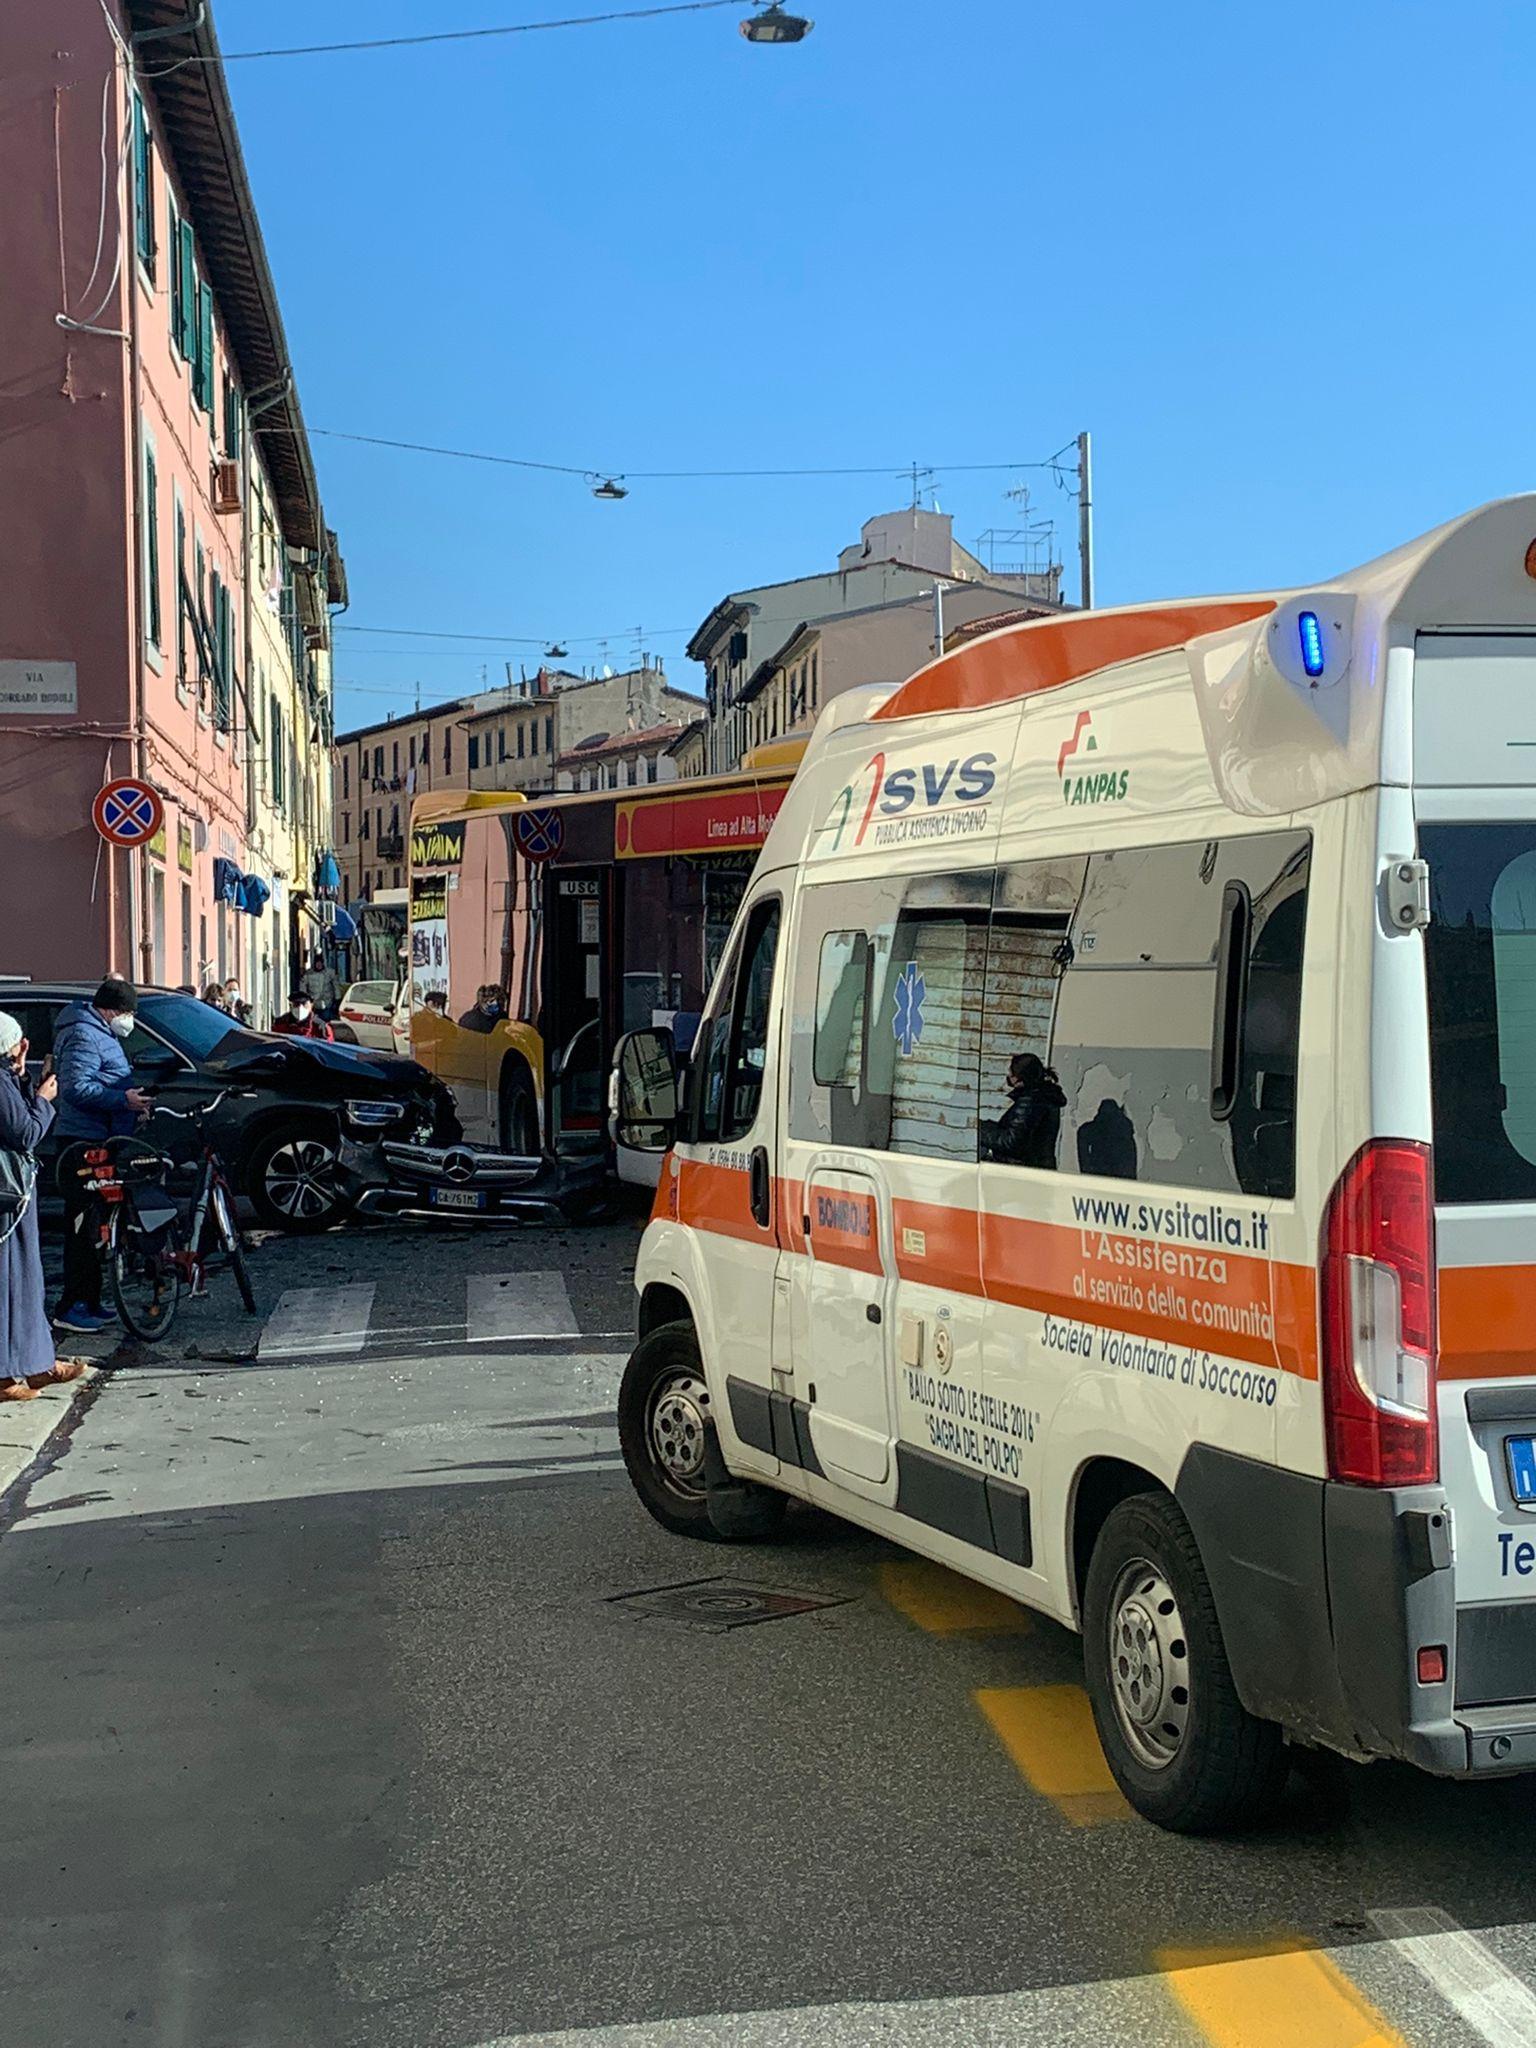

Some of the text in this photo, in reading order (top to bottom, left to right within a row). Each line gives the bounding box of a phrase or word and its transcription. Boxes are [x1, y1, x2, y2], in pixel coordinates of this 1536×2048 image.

[26, 672, 44, 682] VIA
[879, 752, 998, 815] SVS
[1070, 769, 1130, 806] ANPAS
[707, 818, 728, 838] Linea
[728, 816, 739, 836] ad
[740, 815, 757, 835] Alta
[908, 815, 949, 841] ASSISTENZA
[950, 808, 988, 834] LIVORNO
[567, 881, 600, 894] USC
[1072, 1196, 1268, 1250] www.svsitalia.it
[1080, 1229, 1228, 1284] L'Assistenza
[1073, 1269, 1274, 1341] al servizio della comunità
[1100, 1326, 1176, 1381] Volontaria
[1181, 1349, 1198, 1386] di
[1199, 1353, 1278, 1406] Soccorso
[938, 1380, 966, 1418] SOTTO
[968, 1389, 979, 1422] LE
[980, 1393, 1009, 1434] STELLE
[963, 1426, 983, 1465] DEL
